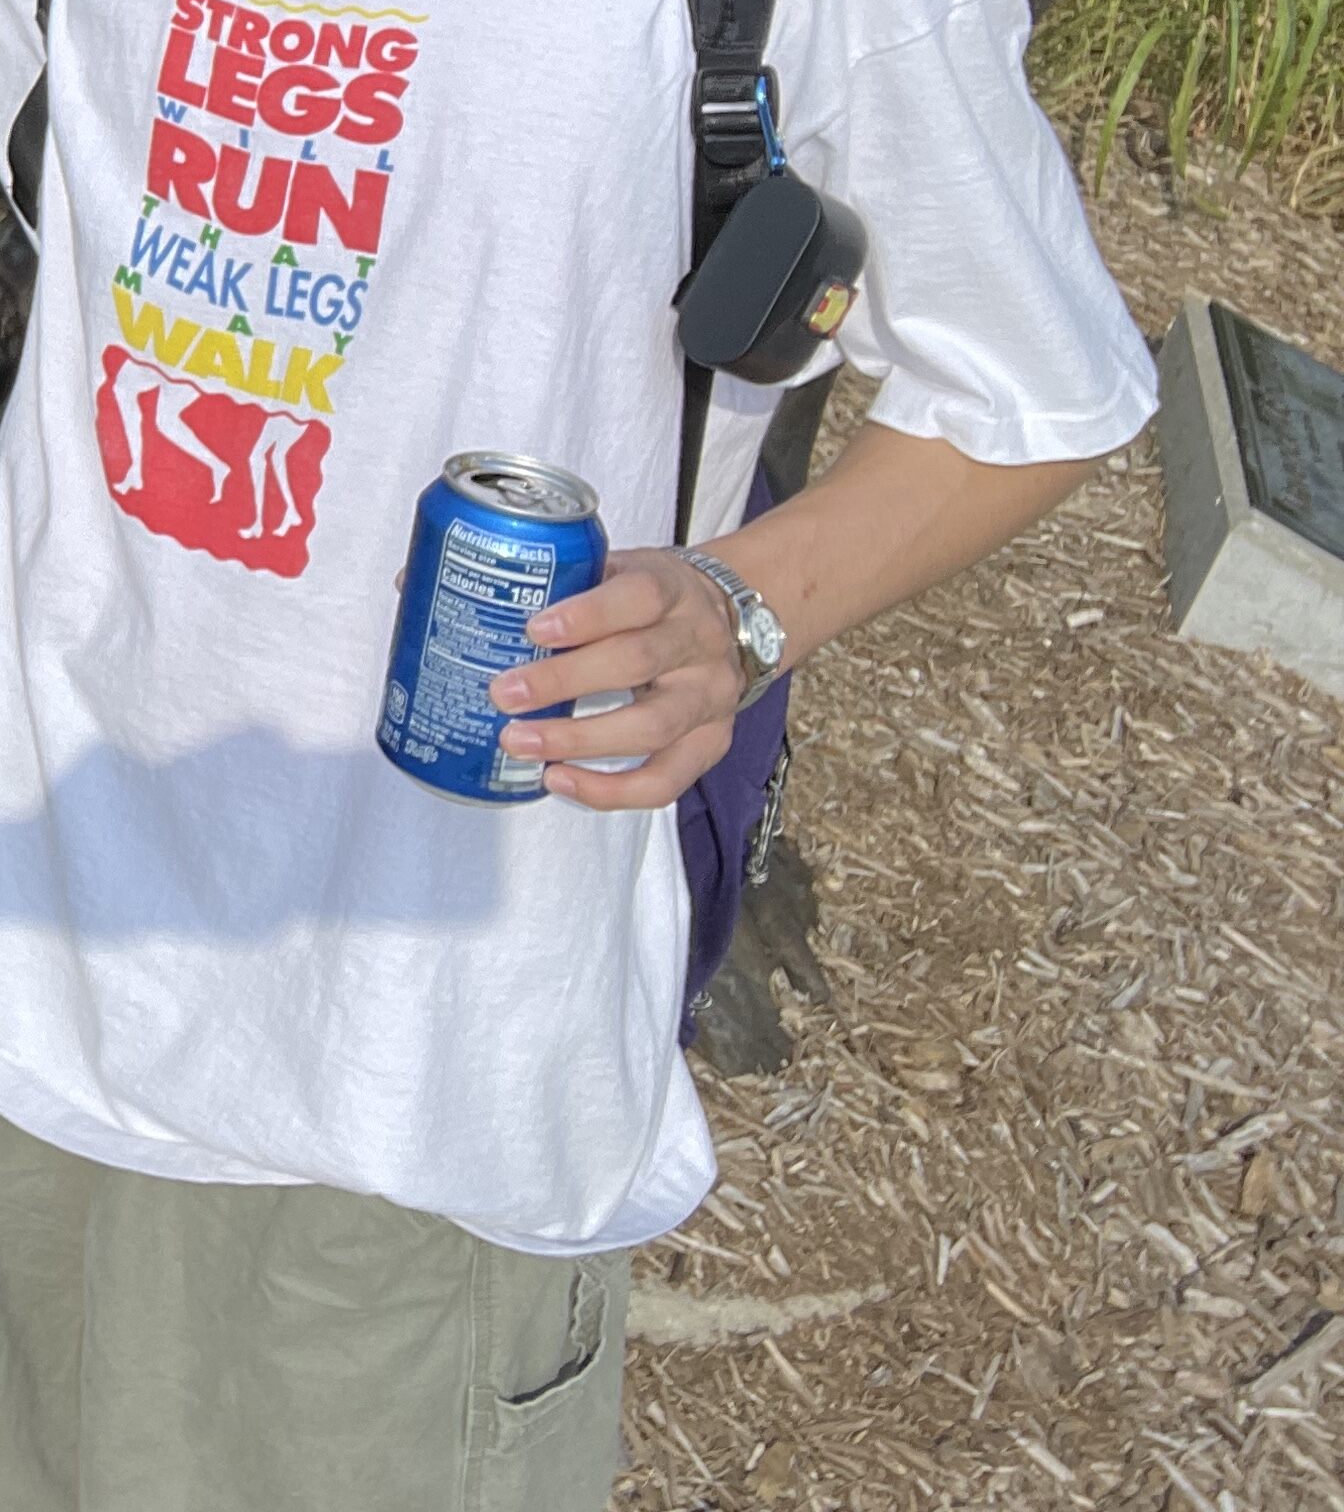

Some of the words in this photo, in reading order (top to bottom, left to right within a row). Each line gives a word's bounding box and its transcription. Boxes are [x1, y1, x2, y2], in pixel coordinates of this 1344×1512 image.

[157, 27, 410, 145] LEGS
[157, 96, 394, 172] WILL
[147, 117, 389, 254] RUN
[130, 217, 253, 312] WEAK
[265, 266, 369, 331] LEGS
[143, 194, 376, 279] THAT
[112, 283, 346, 414] WALK
[114, 264, 353, 356] MAY
[442, 568, 496, 598] Calories
[511, 587, 545, 605] 150
[451, 524, 509, 558] Nutrition
